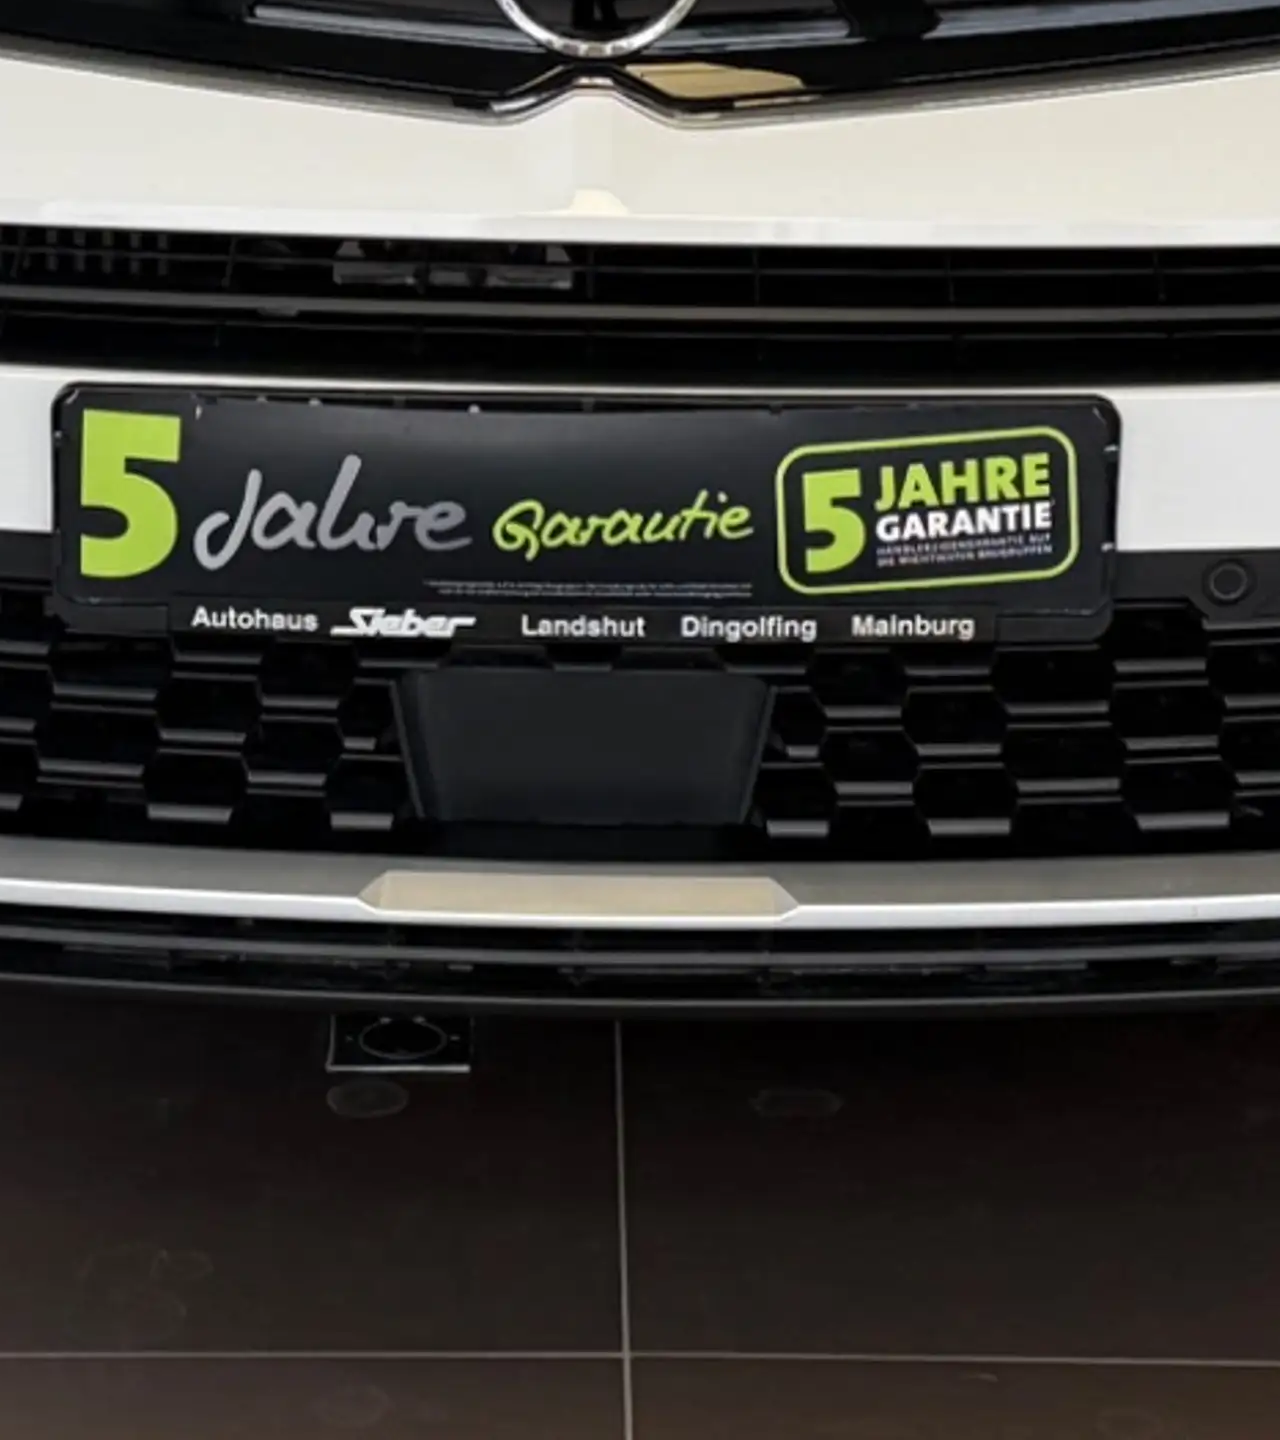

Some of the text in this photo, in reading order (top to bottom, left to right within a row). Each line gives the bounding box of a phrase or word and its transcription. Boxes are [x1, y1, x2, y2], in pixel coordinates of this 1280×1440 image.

[80, 408, 754, 579] 5 Jahre Garantie
[801, 452, 1051, 573] 5 JAHRE
[875, 501, 1053, 543] GARANTIE
[191, 605, 976, 644] Autohaus Sieber Landshut Dingolfing Mainburg
